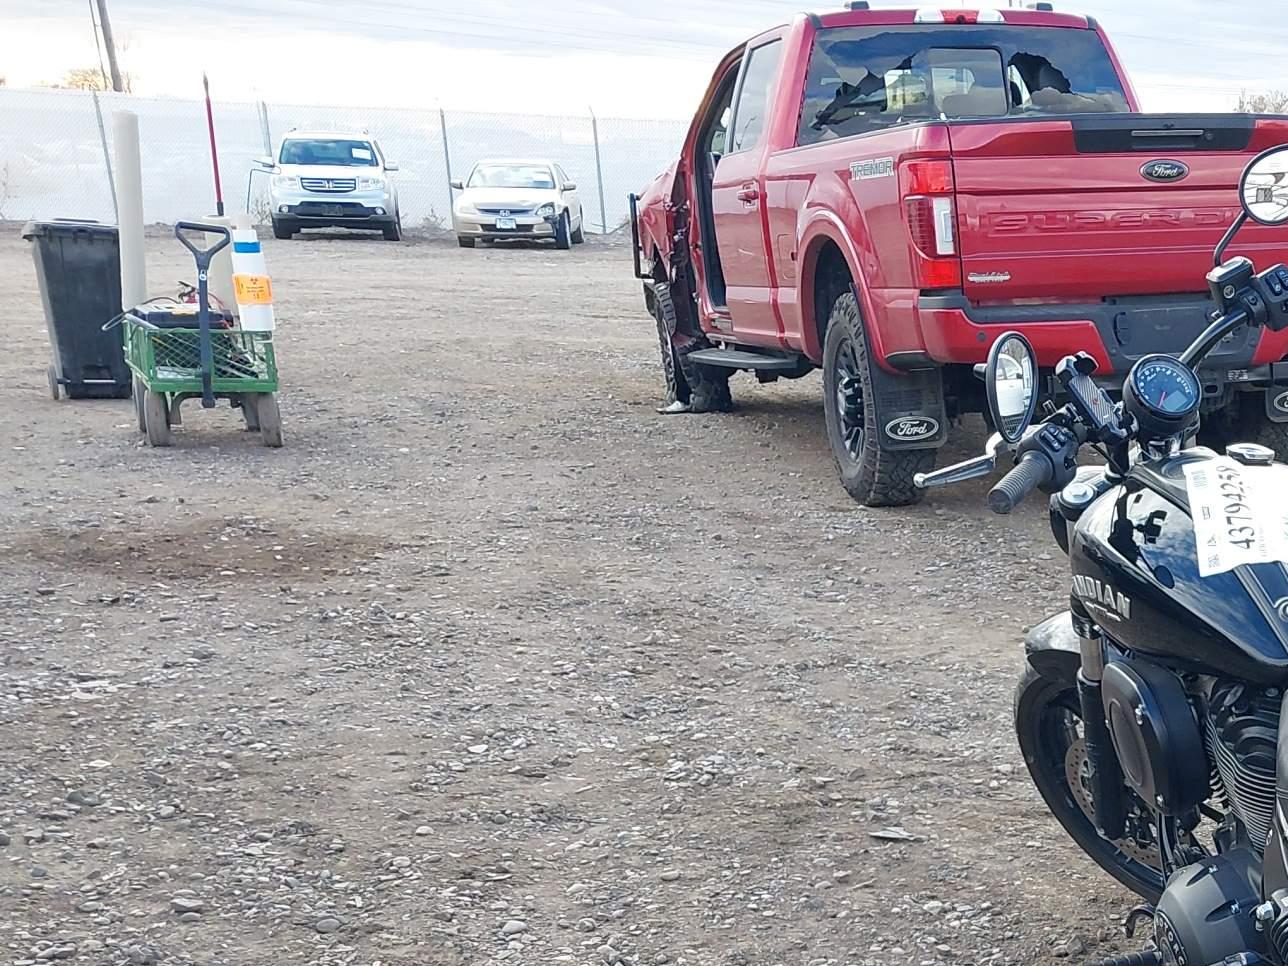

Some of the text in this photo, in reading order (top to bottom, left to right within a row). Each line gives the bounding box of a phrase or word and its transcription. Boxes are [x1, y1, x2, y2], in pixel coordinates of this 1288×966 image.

[850, 158, 894, 180] TREMOR
[990, 208, 1181, 231] SUPER
[897, 420, 928, 435] Ford
